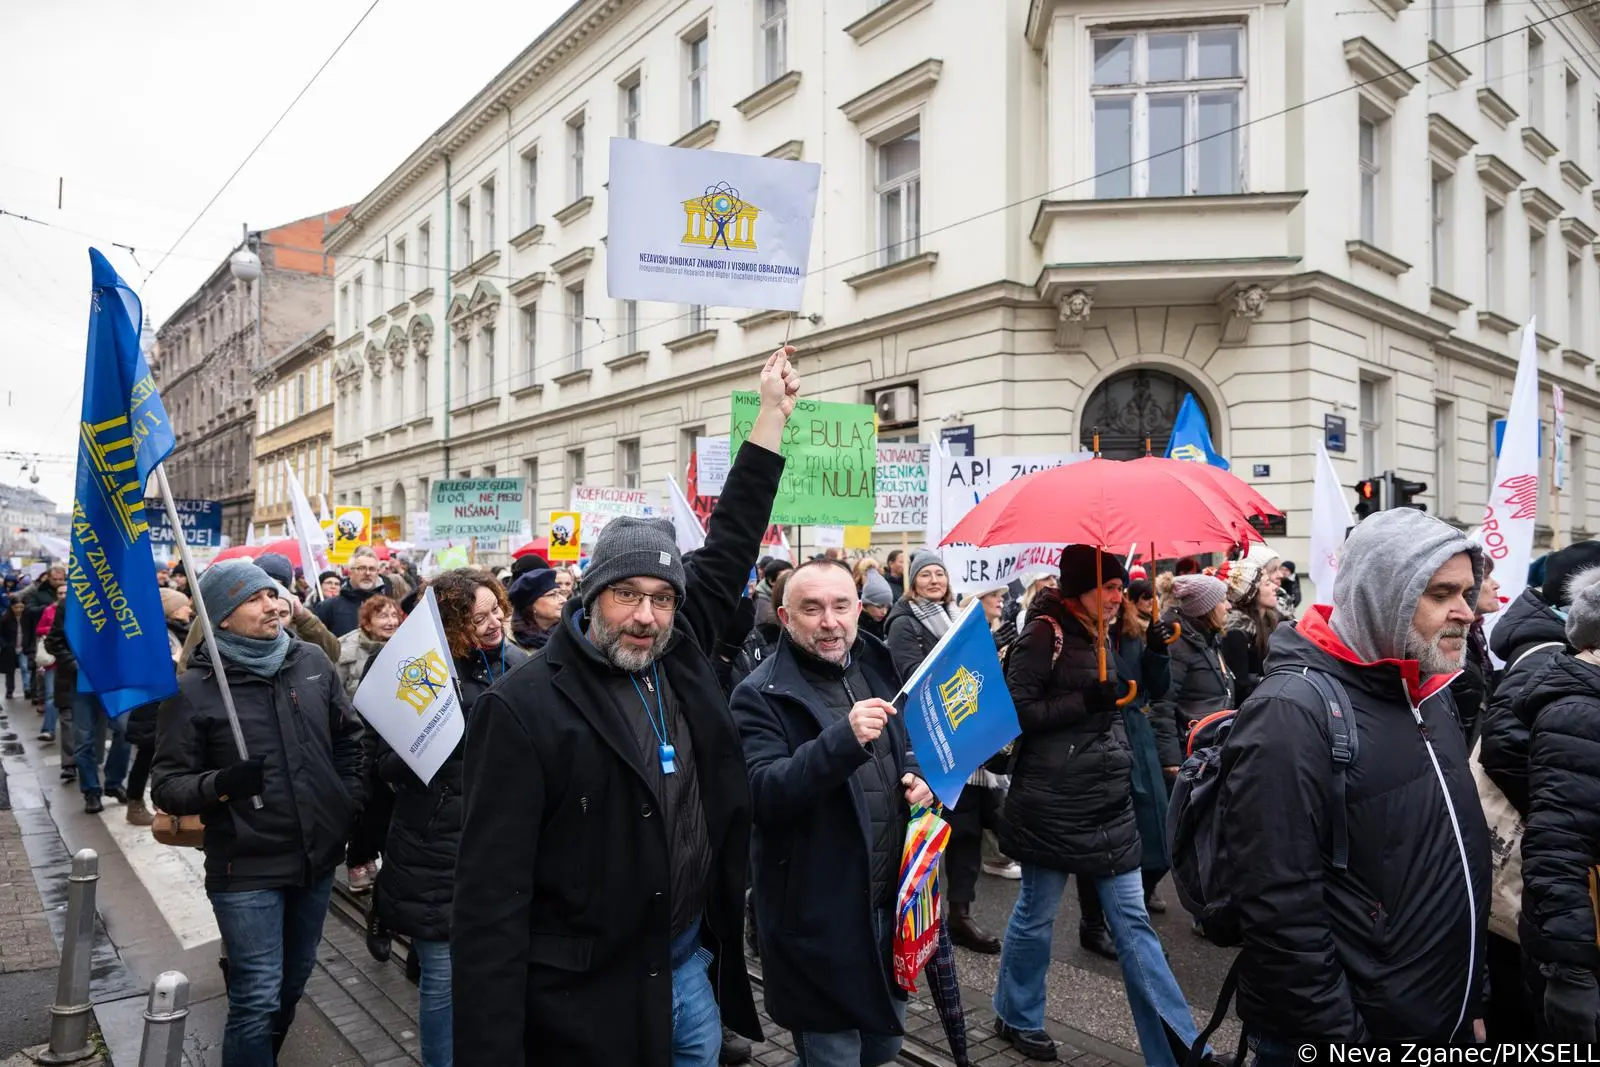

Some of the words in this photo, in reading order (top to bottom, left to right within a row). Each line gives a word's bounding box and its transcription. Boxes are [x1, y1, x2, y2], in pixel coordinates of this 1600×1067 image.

[639, 253, 668, 264] NEZAVISNI
[669, 255, 696, 267] SINDIKAT
[697, 258, 727, 270] ZNANOSTI
[731, 262, 758, 273] VISOKOG
[758, 264, 800, 276] OBRAZOVANJA
[735, 395, 761, 406] MINIS
[810, 419, 876, 450] BULA?
[822, 467, 877, 498] NULA!
[876, 464, 925, 479] SLENIKA
[479, 493, 495, 502] NE
[161, 513, 196, 526] NMA
[455, 503, 500, 520] NIŠANA!
[962, 560, 990, 583] JER
[86, 546, 143, 640] ZNANOSTI
[423, 712, 442, 734] SINDIKAT
